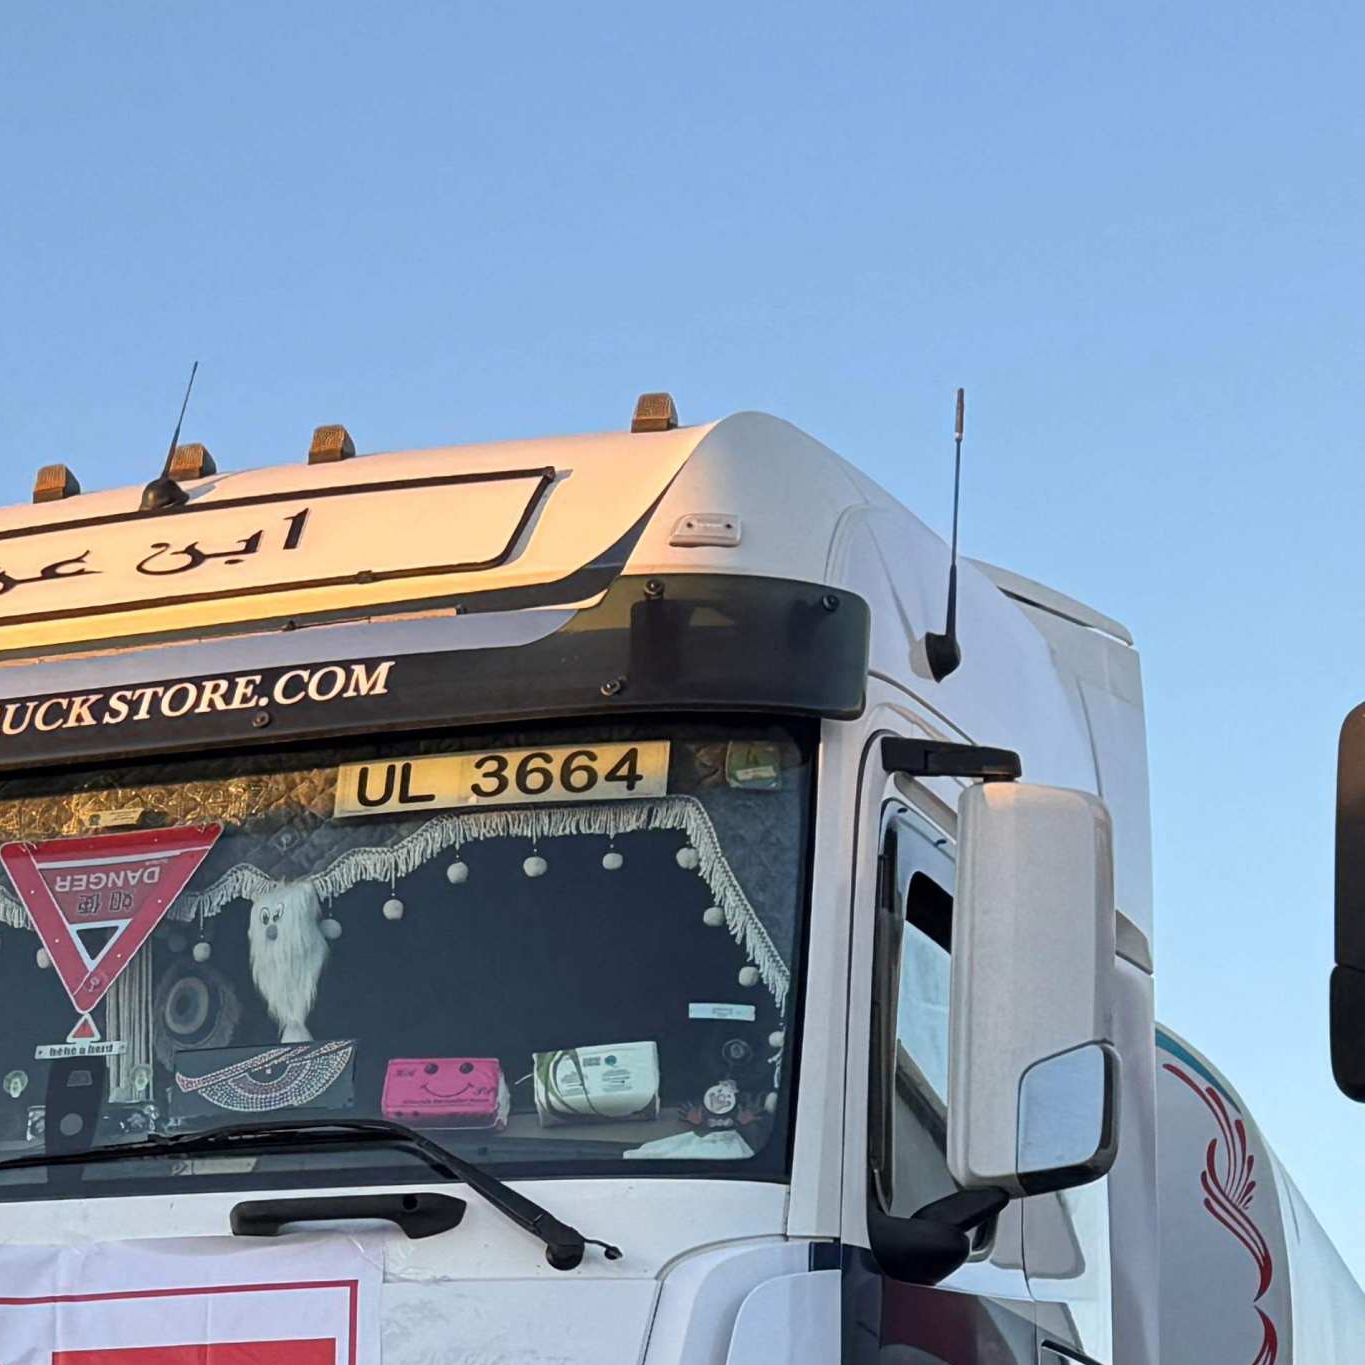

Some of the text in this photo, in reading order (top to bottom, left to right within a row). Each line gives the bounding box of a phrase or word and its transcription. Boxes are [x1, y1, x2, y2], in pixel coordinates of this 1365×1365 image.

[136, 508, 310, 576] ابن
[357, 747, 644, 807] UL 3664
[55, 865, 160, 892] DANGER
